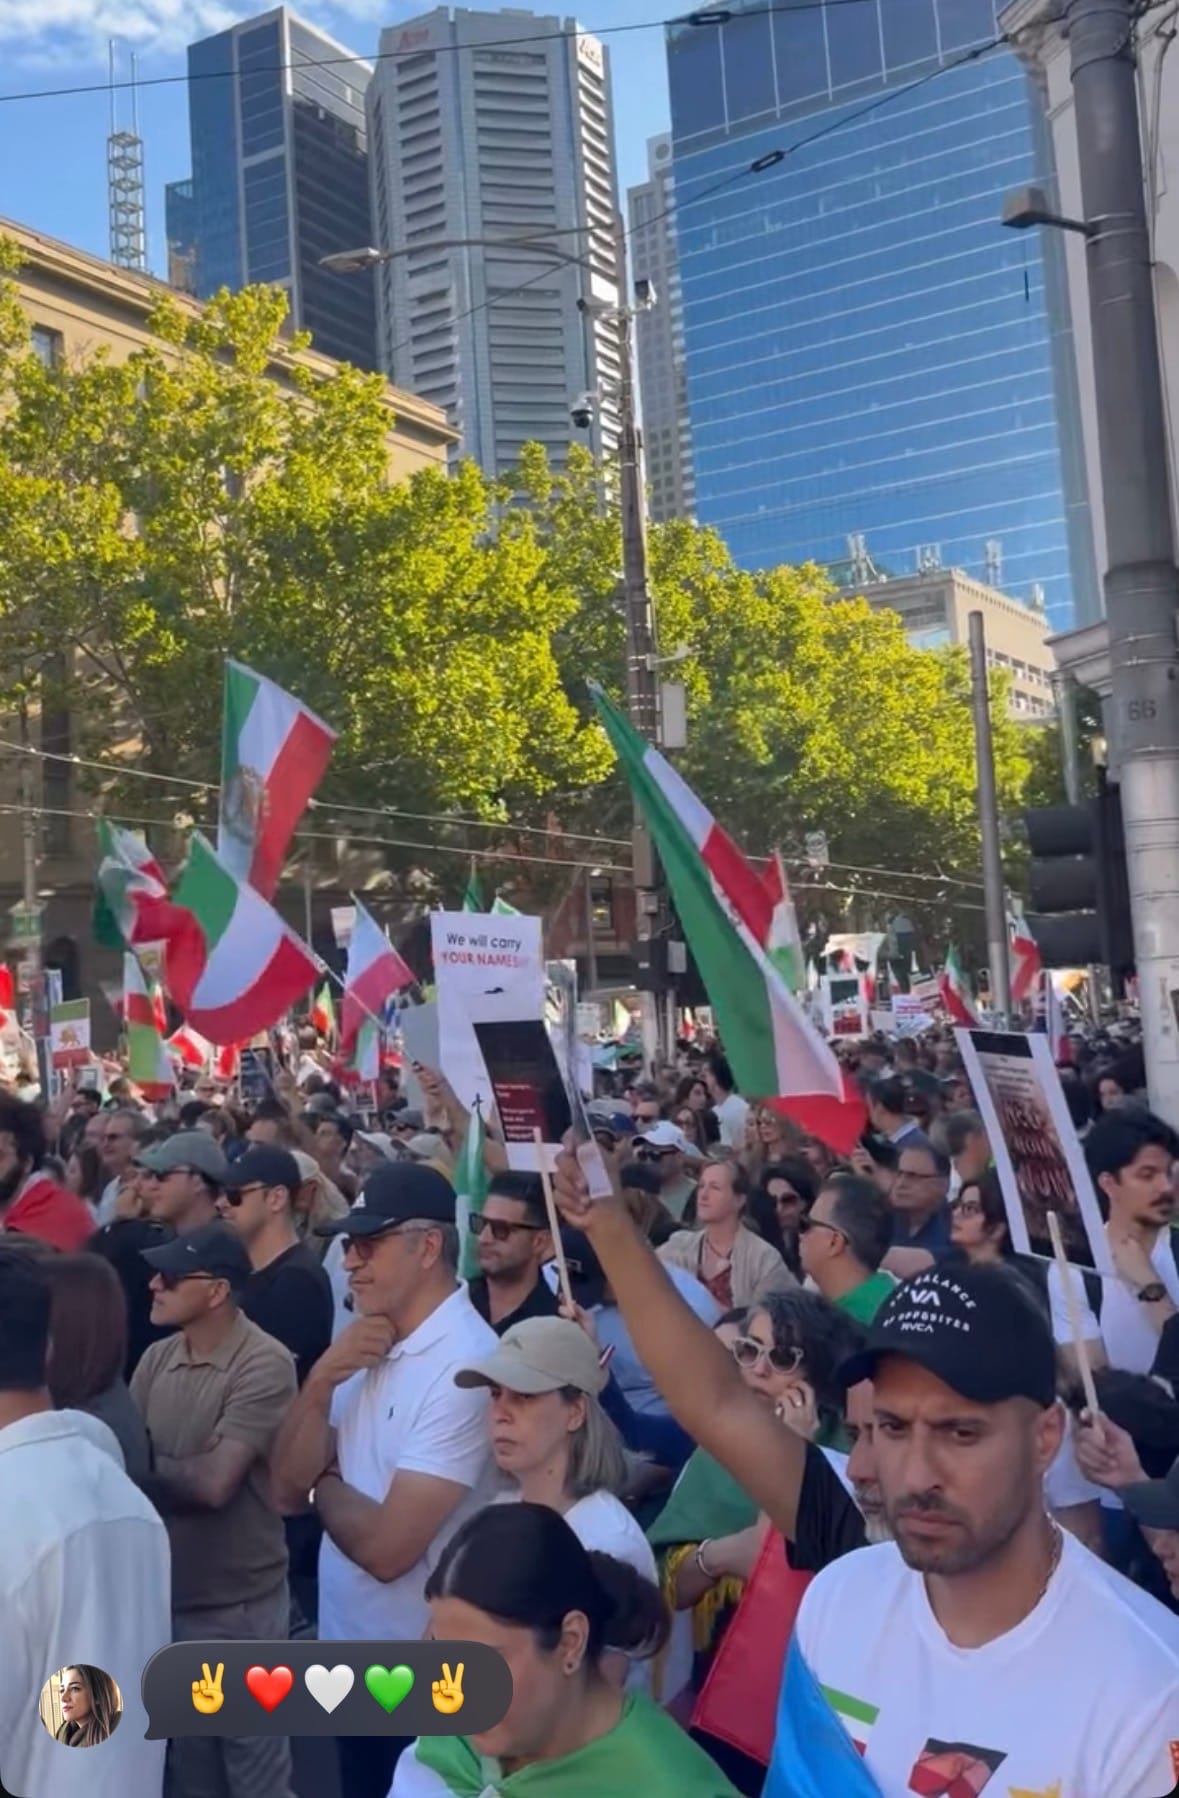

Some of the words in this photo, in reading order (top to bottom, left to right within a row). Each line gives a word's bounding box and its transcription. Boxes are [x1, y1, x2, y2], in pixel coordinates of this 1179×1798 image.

[446, 932, 465, 946] We
[469, 934, 487, 948] will
[490, 937, 522, 952] carry
[442, 950, 474, 964] YOUR
[914, 1273, 977, 1309] BALANCE
